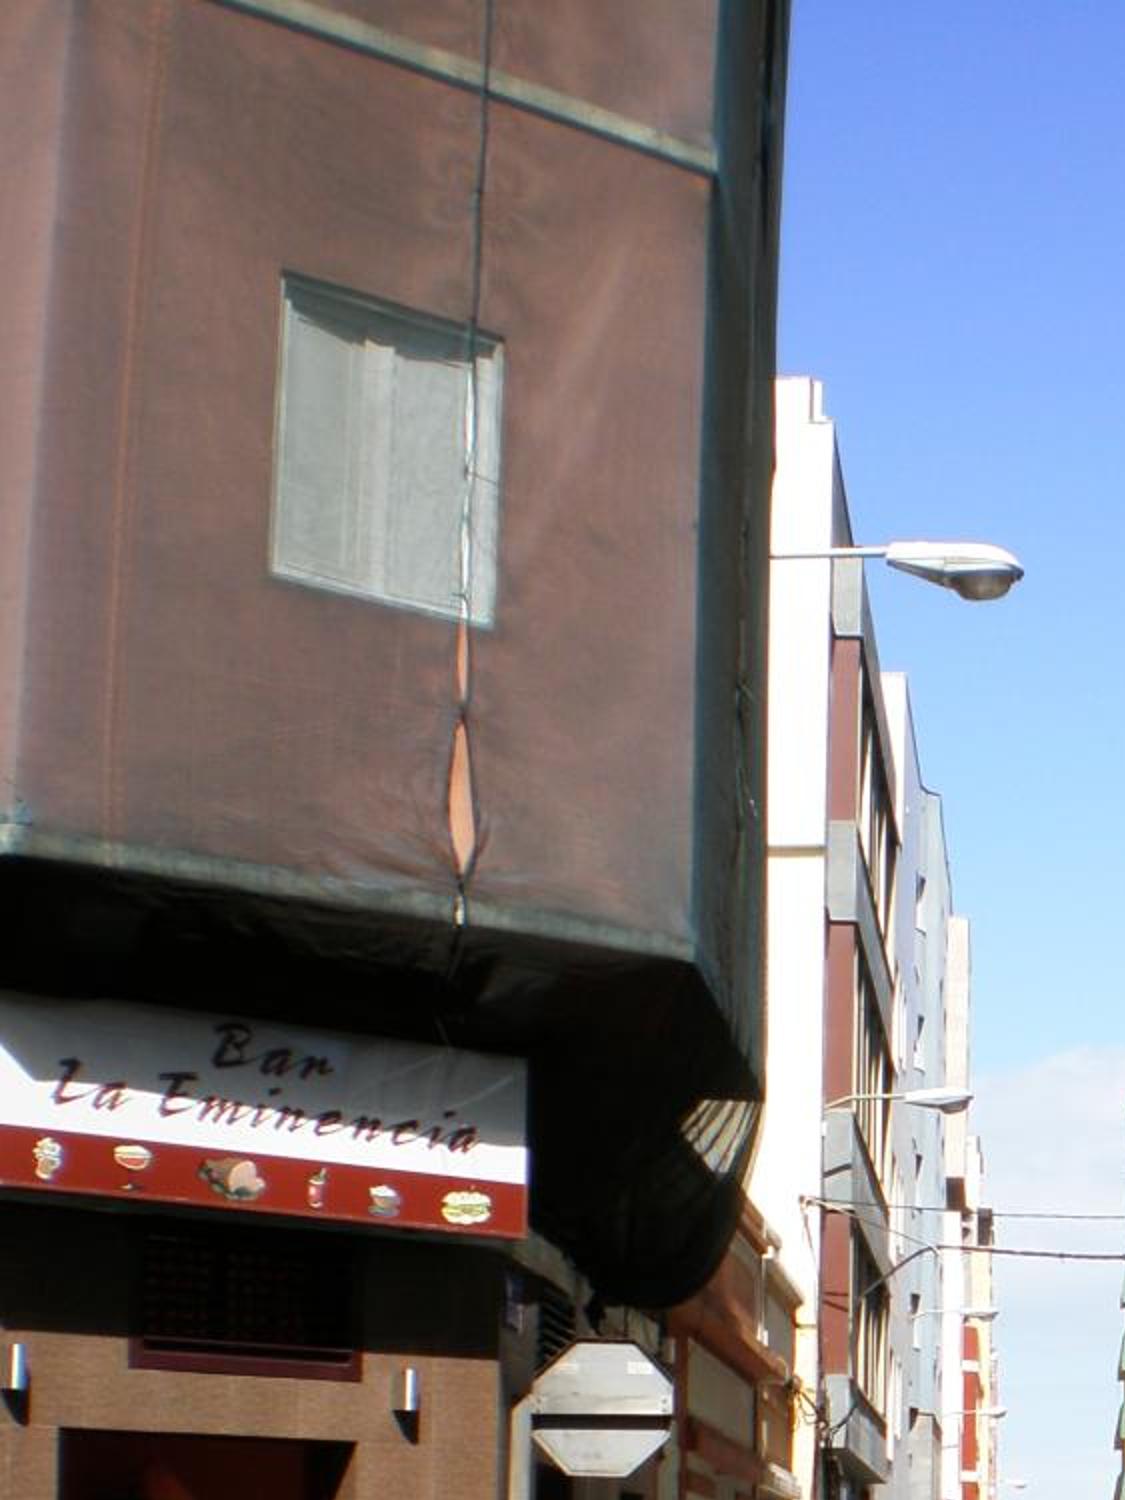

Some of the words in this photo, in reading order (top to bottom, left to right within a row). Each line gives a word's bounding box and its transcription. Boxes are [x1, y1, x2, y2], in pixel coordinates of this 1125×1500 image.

[212, 1021, 335, 1080] Bar
[51, 1057, 130, 1112] La
[157, 1071, 485, 1154] Eminencia
